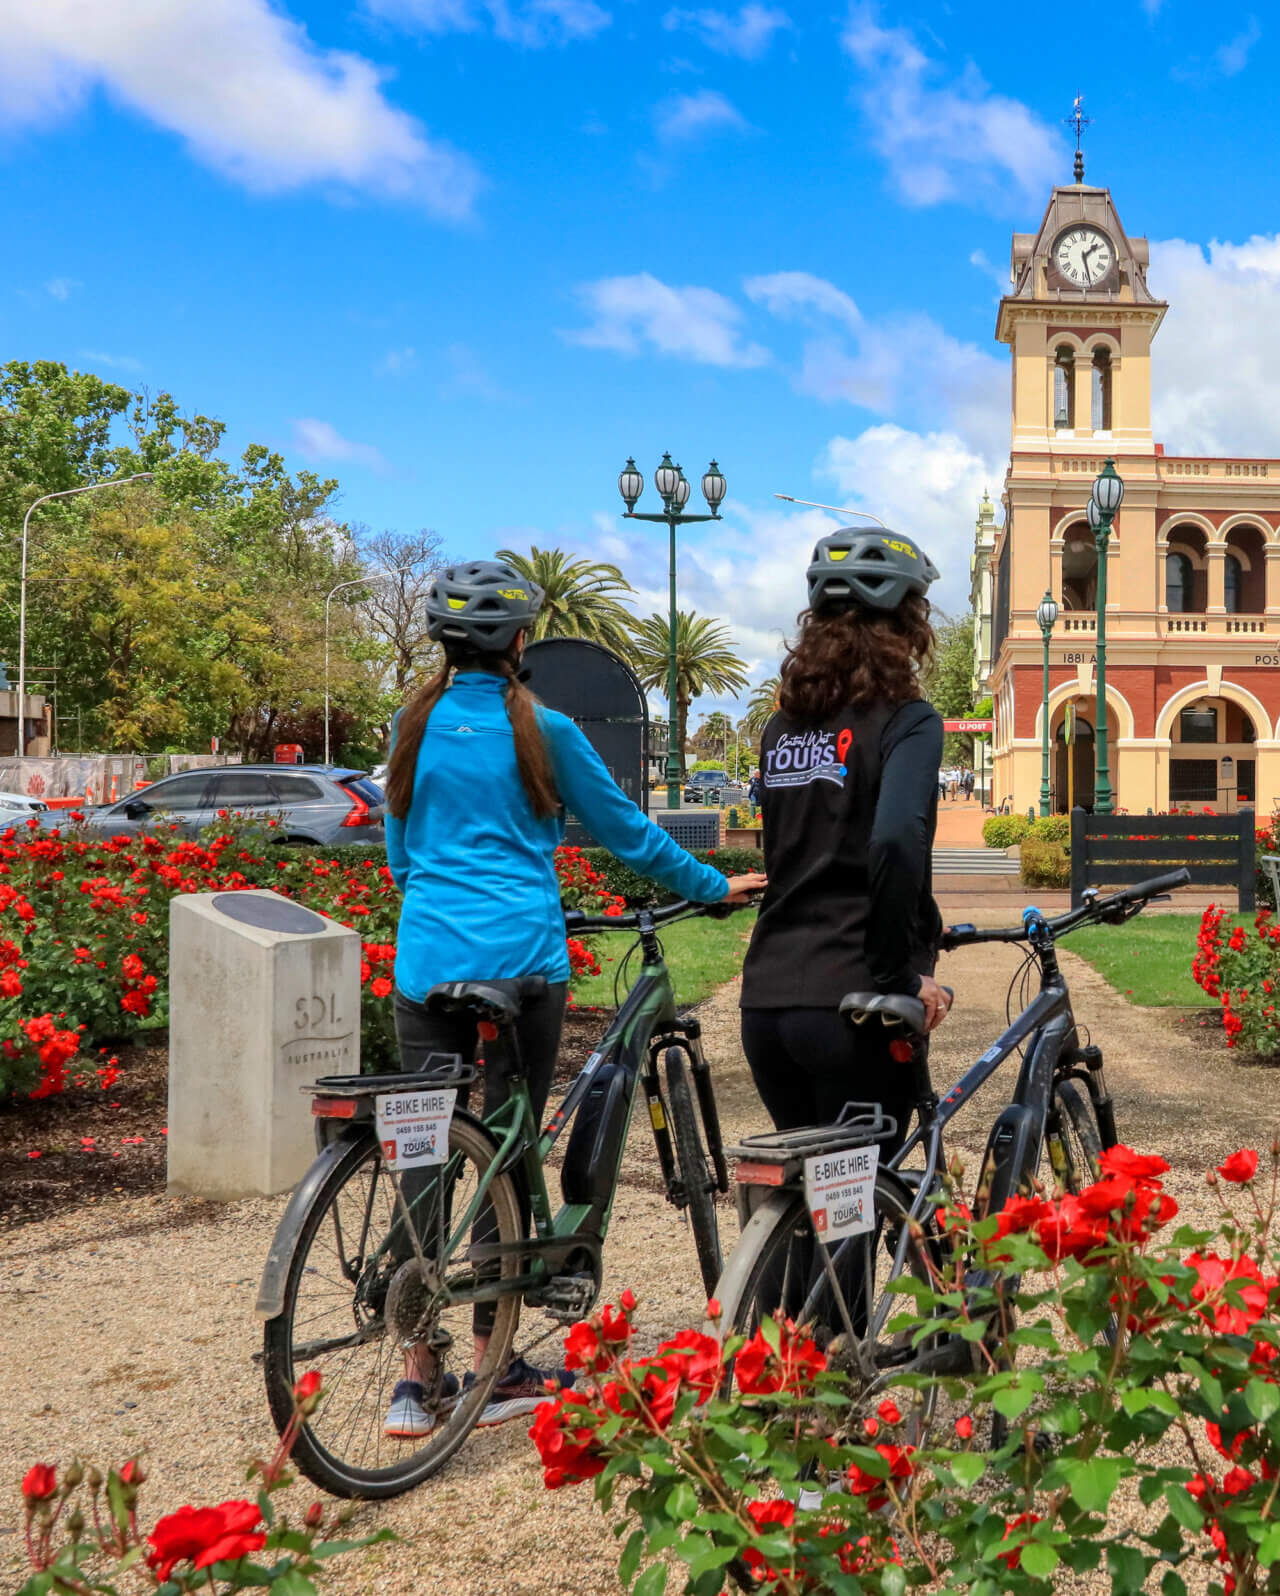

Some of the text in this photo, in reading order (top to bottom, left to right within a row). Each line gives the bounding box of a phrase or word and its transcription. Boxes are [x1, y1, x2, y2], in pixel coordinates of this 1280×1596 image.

[1063, 653, 1085, 664] 1881
[776, 730, 835, 751] Central West
[766, 745, 837, 772] TOURS
[288, 1048, 349, 1065] AUSTRALIA
[385, 1097, 446, 1116] E-BIKE HIRE
[404, 1140, 431, 1152] TOURS
[815, 1155, 870, 1181] E-BIKE HIRE
[833, 1206, 859, 1220] TOURS
